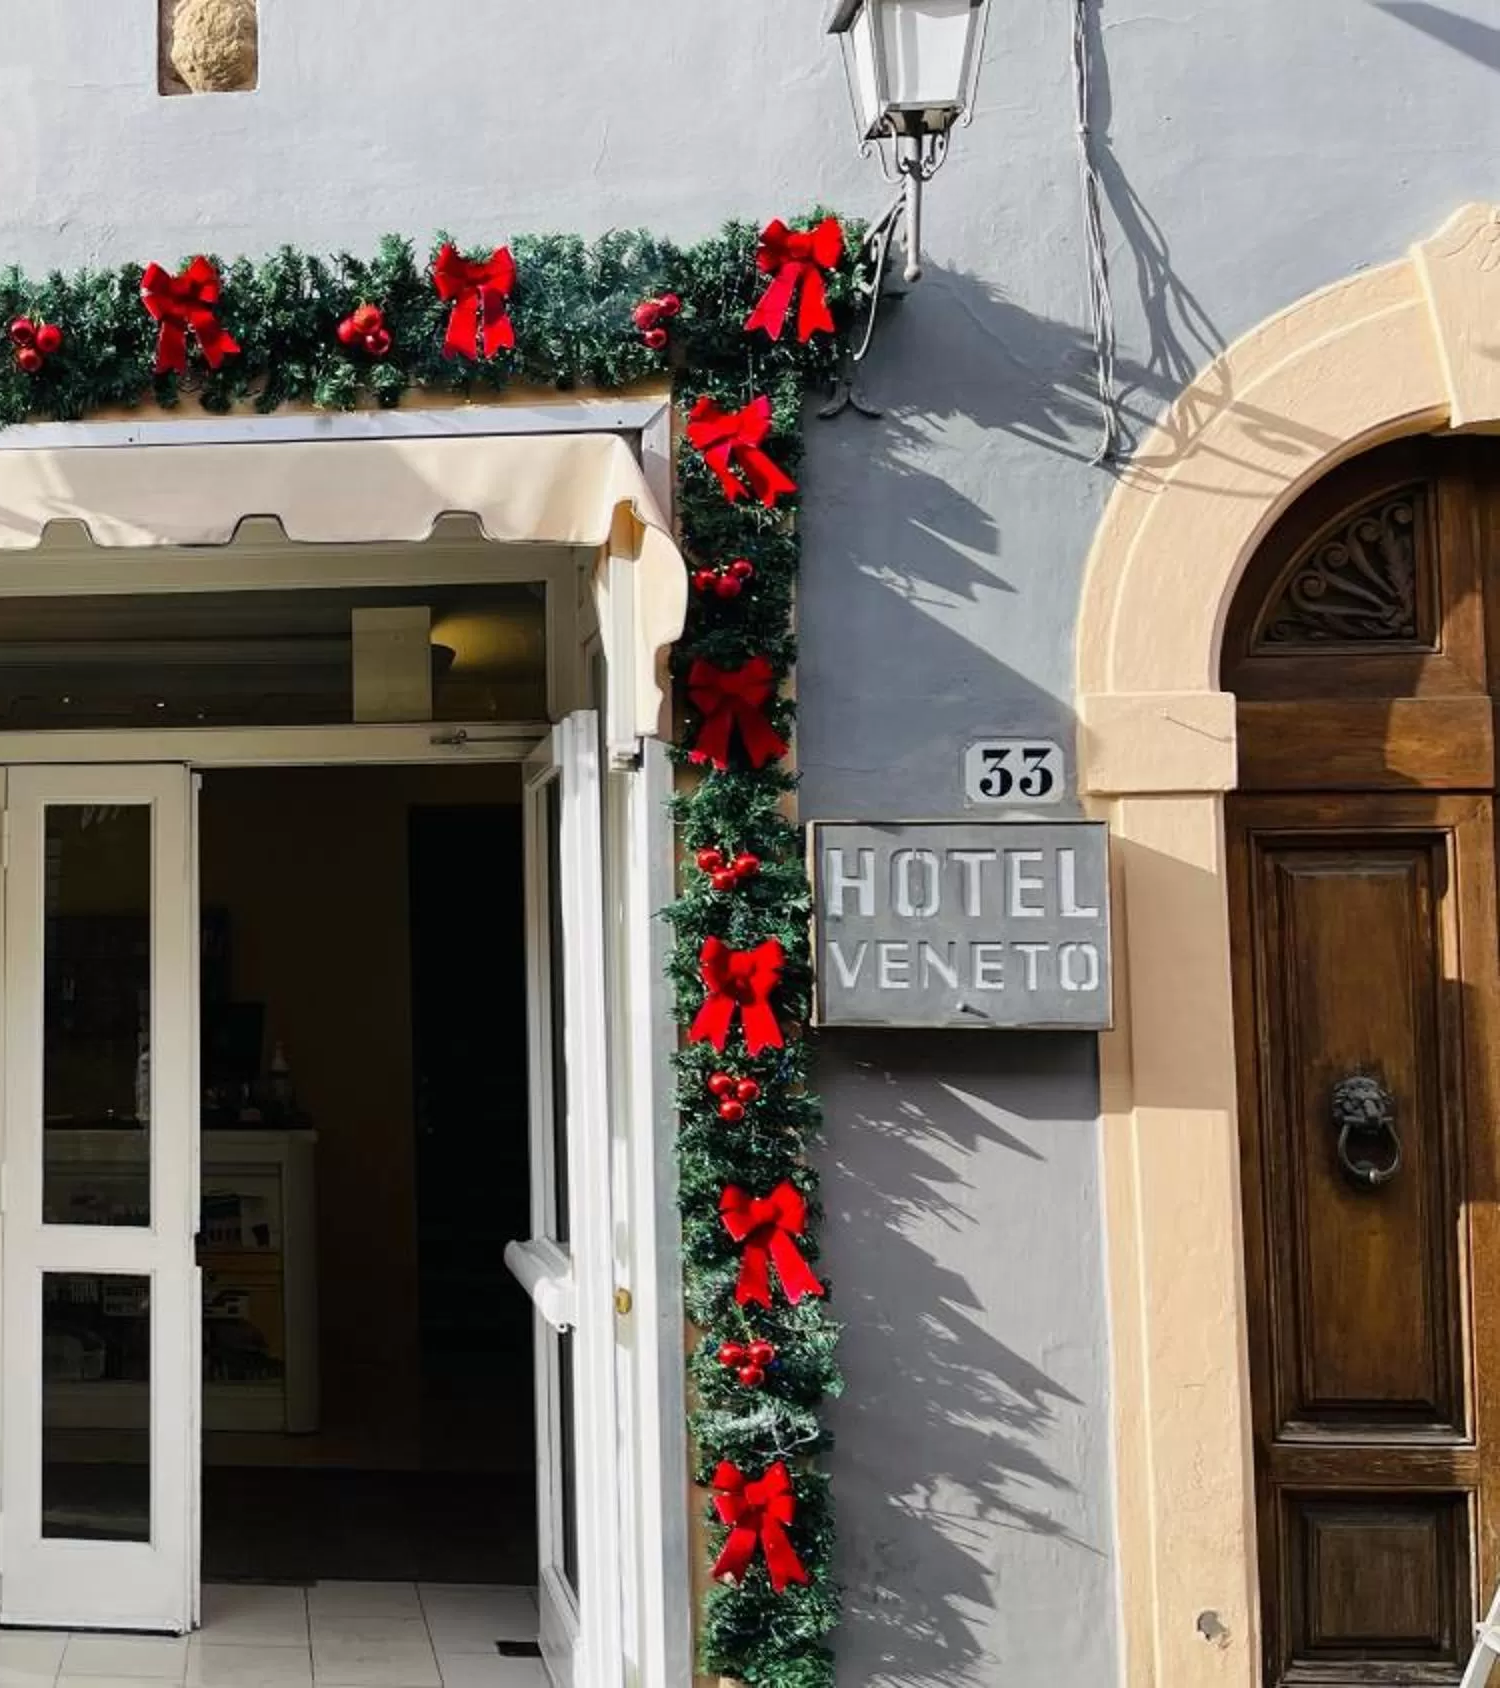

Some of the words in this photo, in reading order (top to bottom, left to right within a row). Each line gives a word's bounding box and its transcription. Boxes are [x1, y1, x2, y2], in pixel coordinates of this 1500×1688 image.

[978, 748, 1054, 797] 33
[825, 849, 1100, 917] HOTEL
[826, 941, 1100, 991] VENETO
